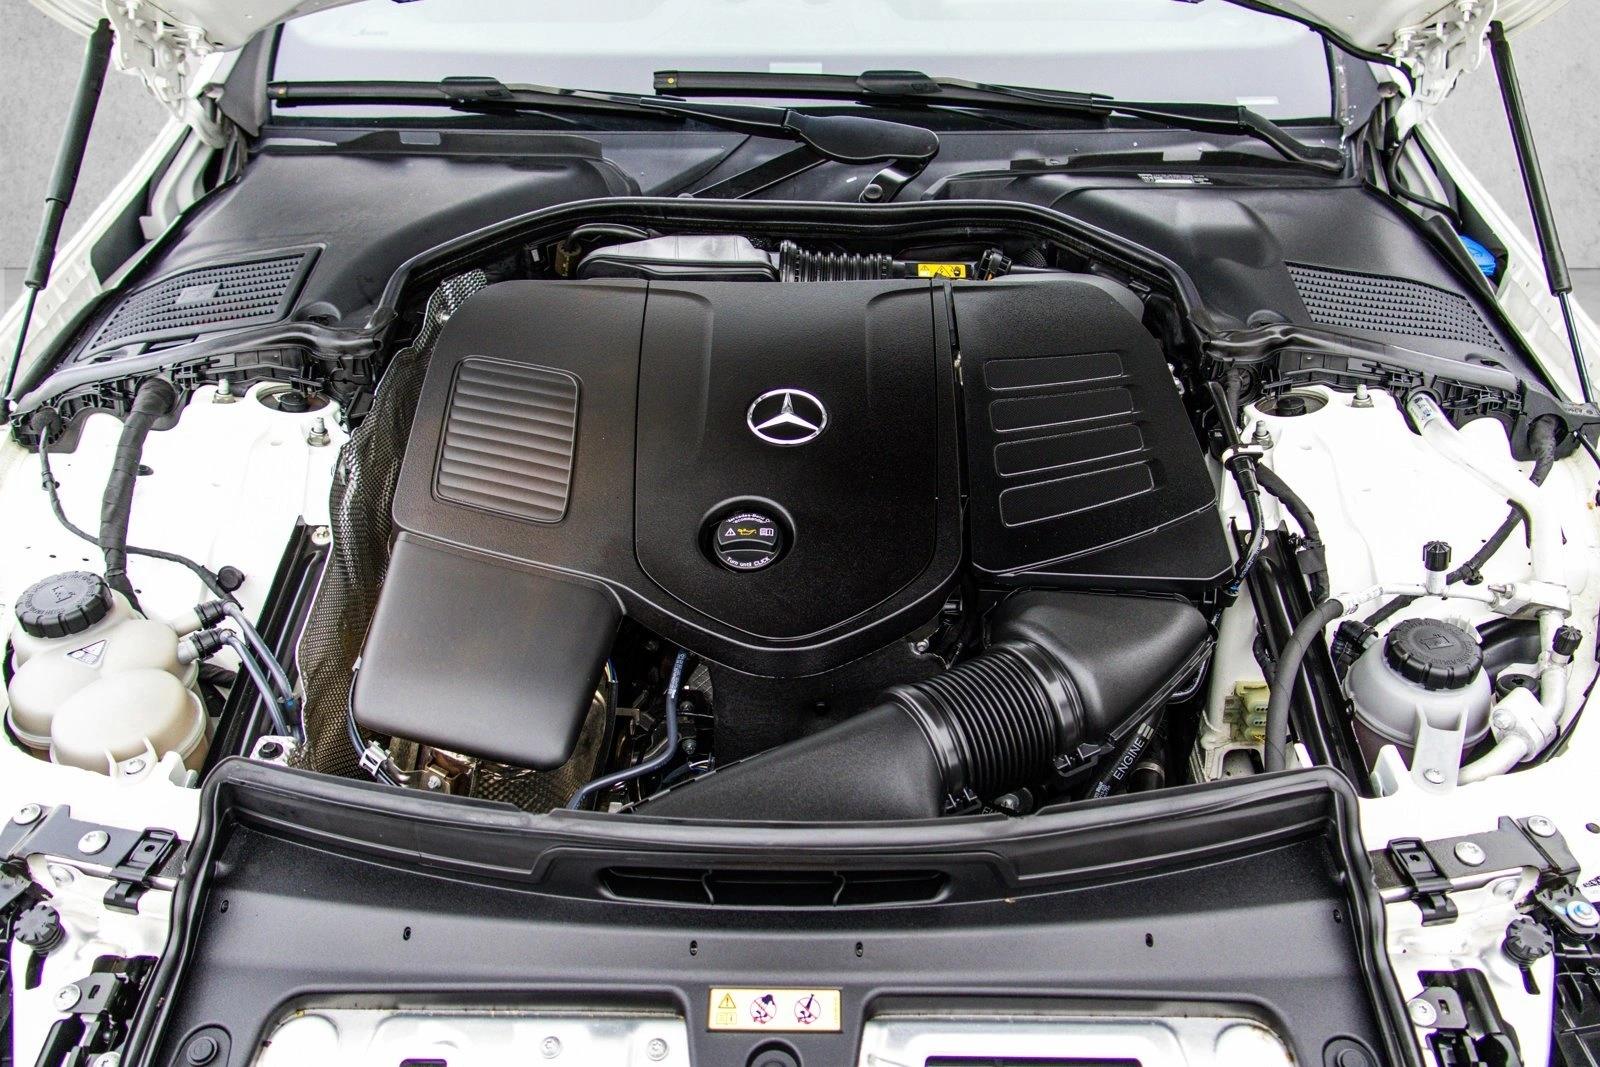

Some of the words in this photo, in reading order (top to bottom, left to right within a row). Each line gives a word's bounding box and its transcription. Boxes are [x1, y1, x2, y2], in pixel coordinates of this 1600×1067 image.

[727, 556, 739, 566] Turn
[753, 556, 770, 566] CLICK
[1113, 737, 1145, 781] ENGINE
